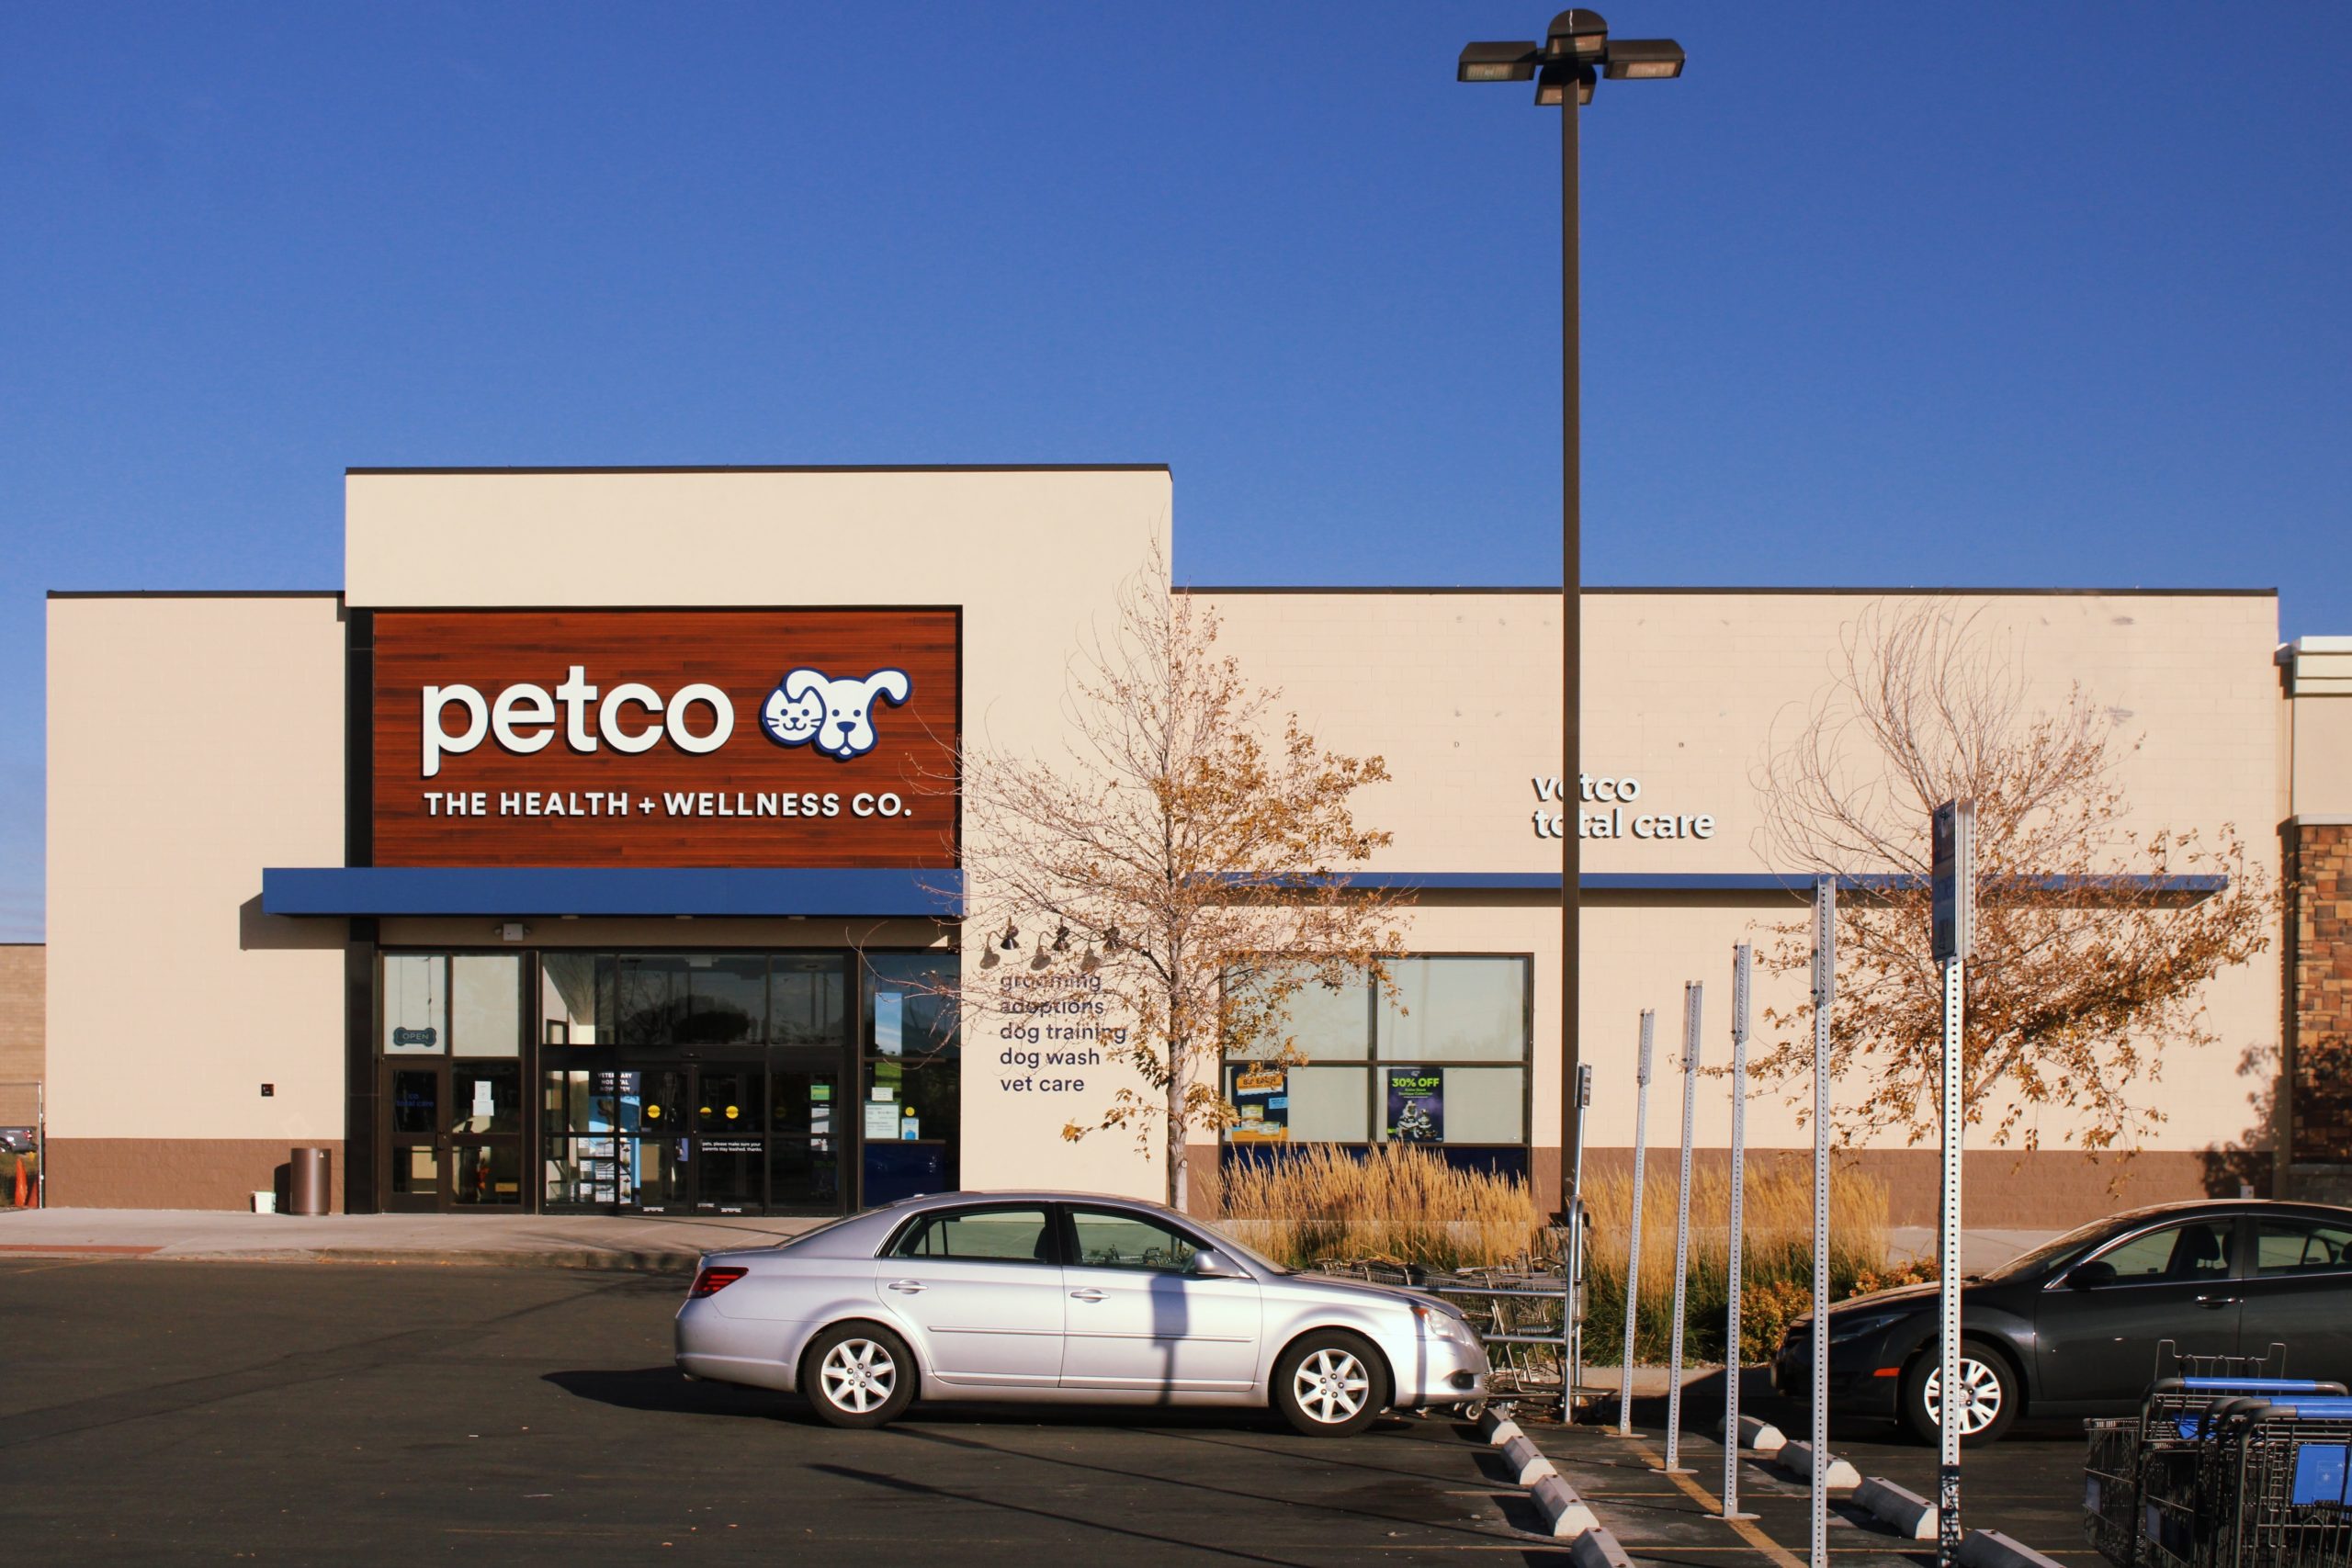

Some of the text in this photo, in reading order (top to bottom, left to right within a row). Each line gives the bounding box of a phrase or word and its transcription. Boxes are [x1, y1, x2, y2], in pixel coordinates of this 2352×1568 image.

[422, 665, 735, 777] petco
[1533, 773, 1642, 802] vtco
[423, 792, 912, 817] THE HEALTH + WELLNESS CO.
[1634, 813, 1716, 838] care
[1000, 1022, 1040, 1044] dog
[1000, 1047, 1100, 1069] dog wash
[1000, 1076, 1085, 1092] vet care
[1391, 1077, 1440, 1088] 30% OFF
